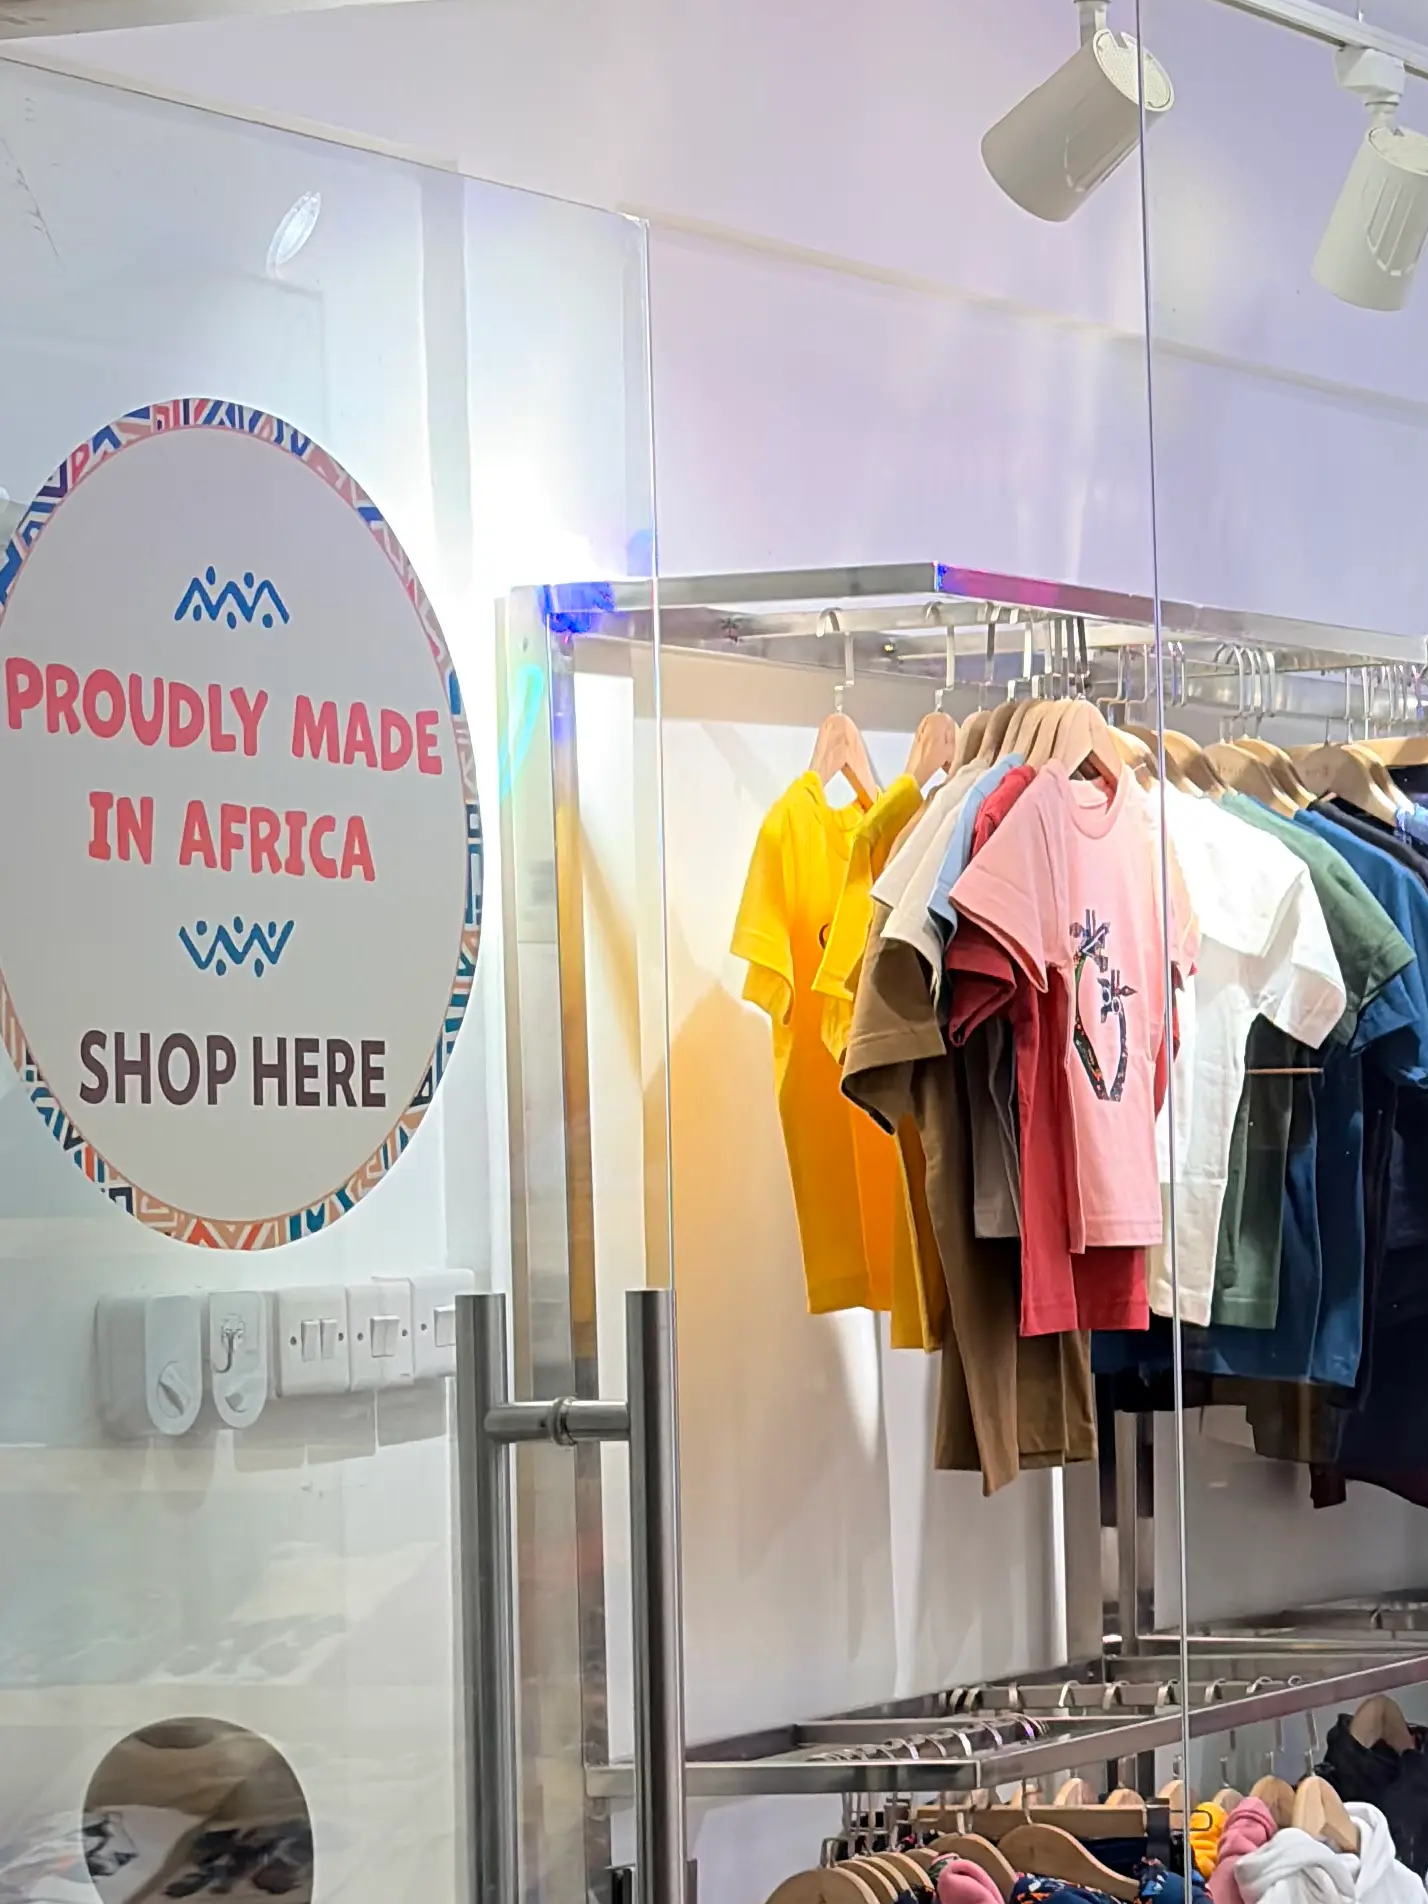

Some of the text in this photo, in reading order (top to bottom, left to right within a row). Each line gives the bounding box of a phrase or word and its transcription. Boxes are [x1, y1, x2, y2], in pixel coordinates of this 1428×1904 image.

[4, 655, 443, 776] PROUDLY MADE
[88, 790, 376, 883] IN AFRICA
[78, 1029, 387, 1109] SHOP HERE
